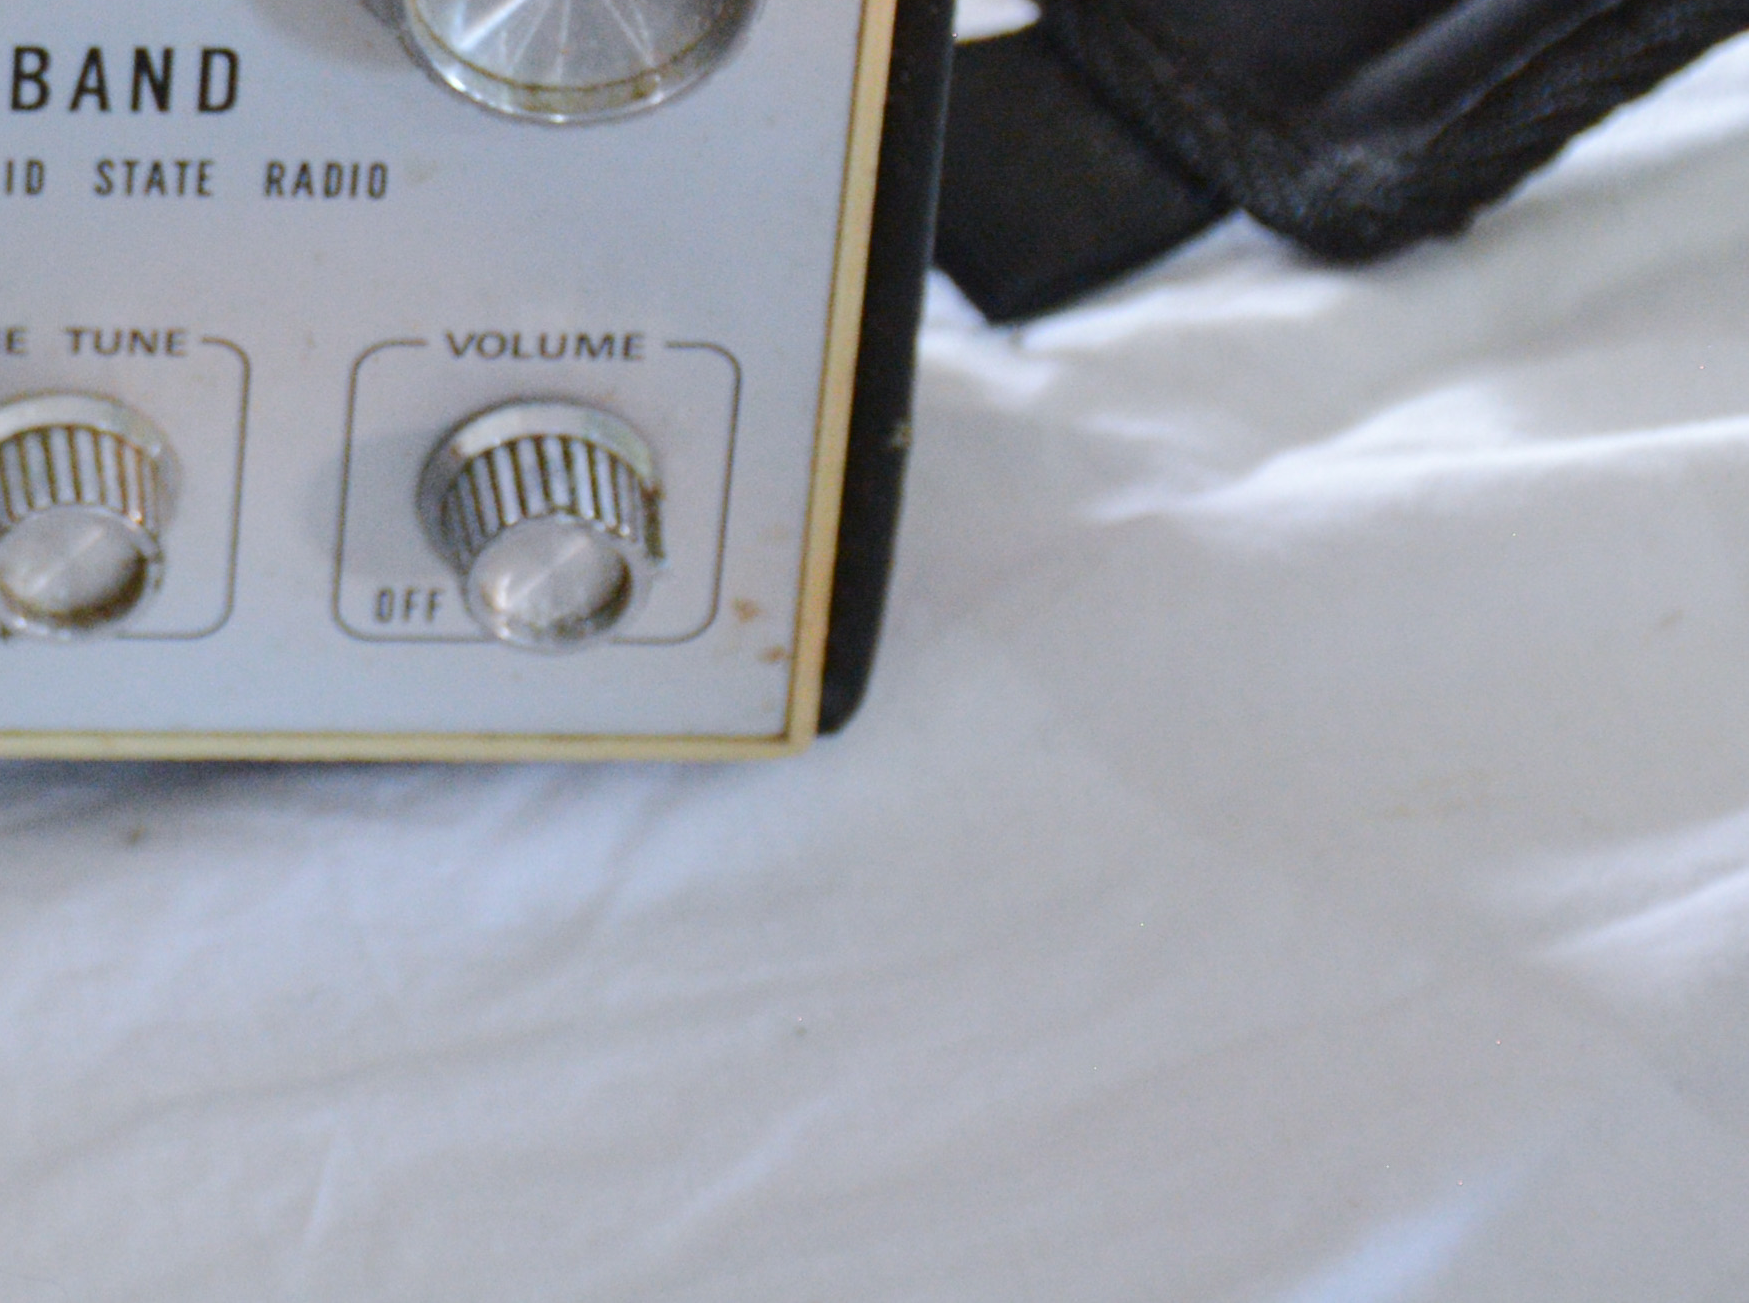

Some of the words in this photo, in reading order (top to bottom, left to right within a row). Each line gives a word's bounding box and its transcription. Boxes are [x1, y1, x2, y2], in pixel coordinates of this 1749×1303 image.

[10, 45, 239, 114] BAND
[93, 157, 215, 199] STATE
[264, 160, 388, 200] RADIO
[66, 327, 190, 358] TUNE
[444, 331, 647, 363] VOLUME
[373, 586, 445, 624] OFF
